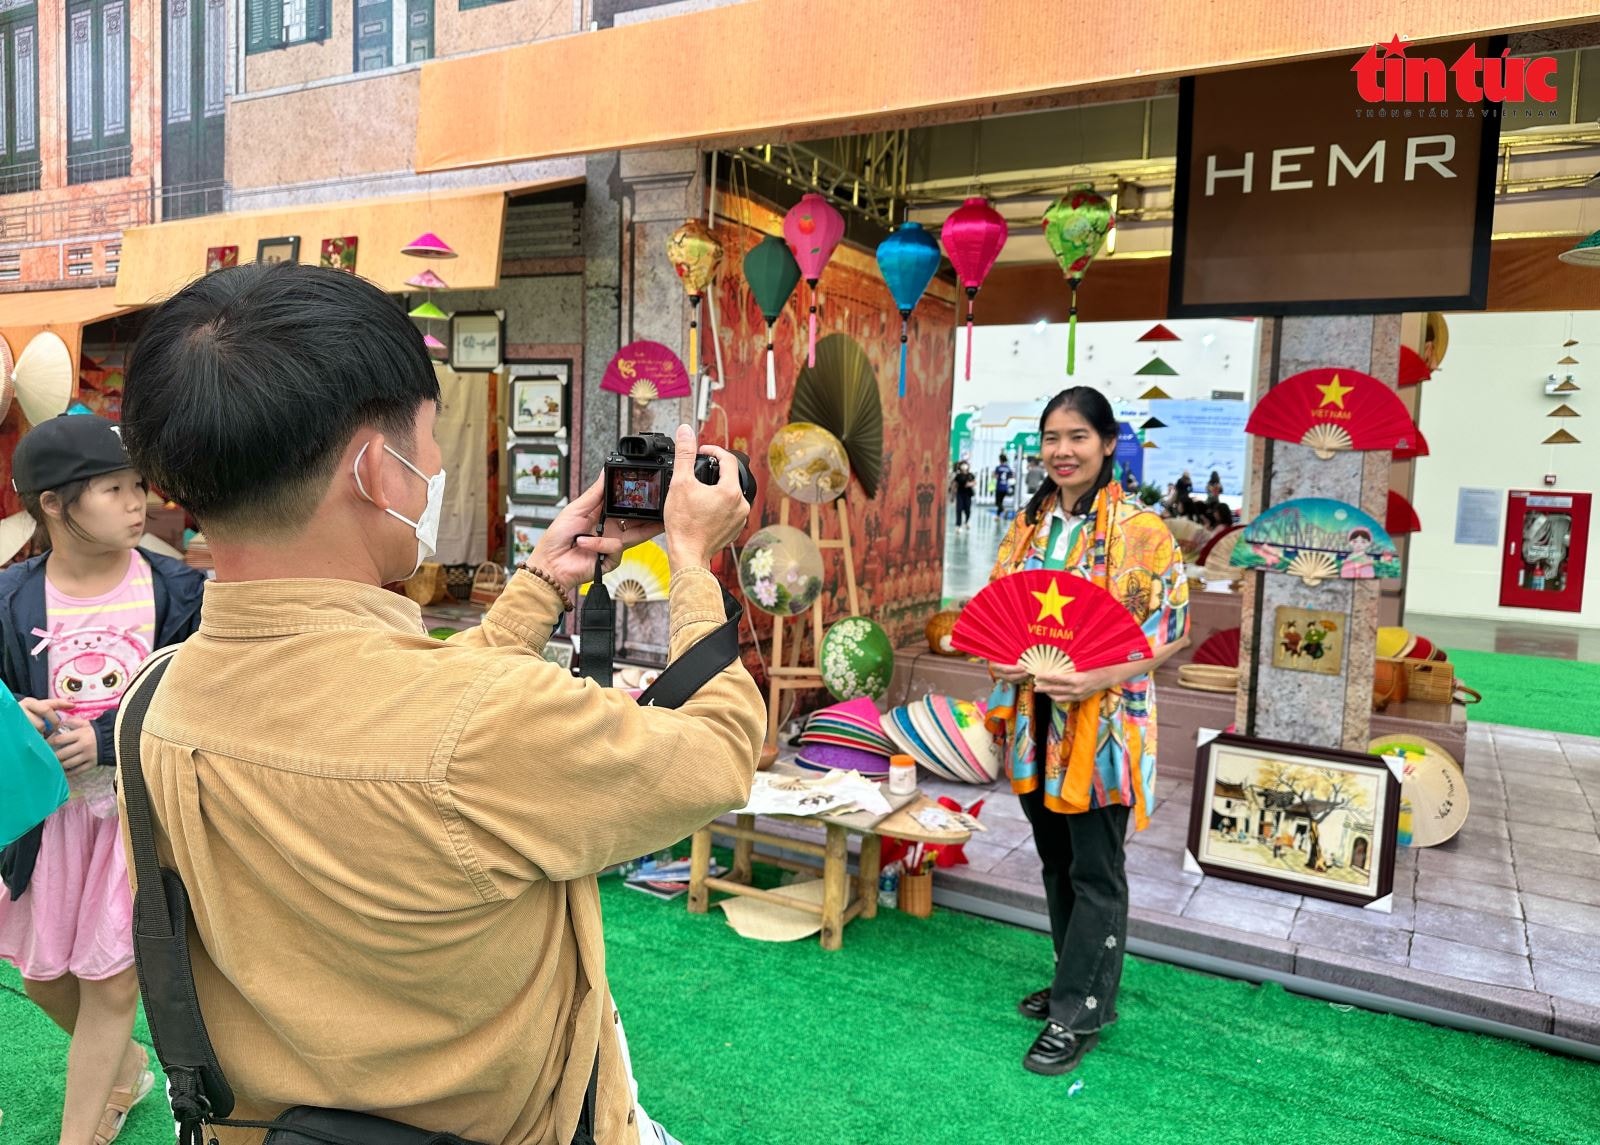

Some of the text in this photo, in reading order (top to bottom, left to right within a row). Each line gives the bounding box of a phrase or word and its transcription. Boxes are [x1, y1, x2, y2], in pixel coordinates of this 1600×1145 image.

[1205, 134, 1458, 196] HEMR
[1330, 410, 1352, 420] NAM
[1027, 623, 1074, 640] VIET NAM
